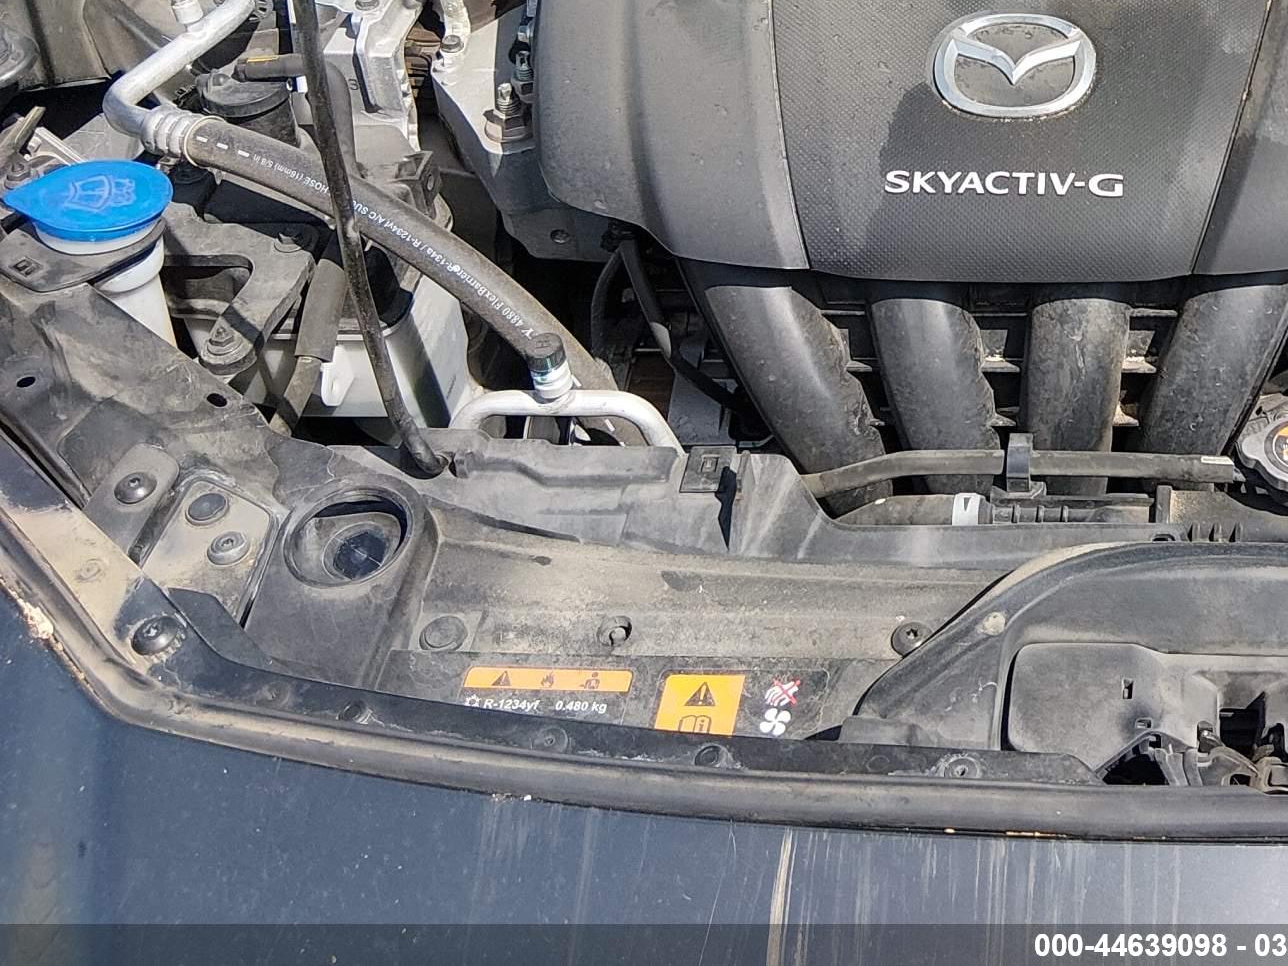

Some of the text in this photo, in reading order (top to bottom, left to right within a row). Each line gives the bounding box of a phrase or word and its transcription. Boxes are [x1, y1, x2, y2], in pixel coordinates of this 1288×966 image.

[304, 176, 330, 194] HOSE
[883, 169, 1125, 198] SKYACTIV-G
[368, 211, 386, 224] A/C
[384, 220, 421, 247] R-1234yf
[502, 307, 523, 327] 4880
[483, 698, 608, 714] R-1234yf 0.480 kg
